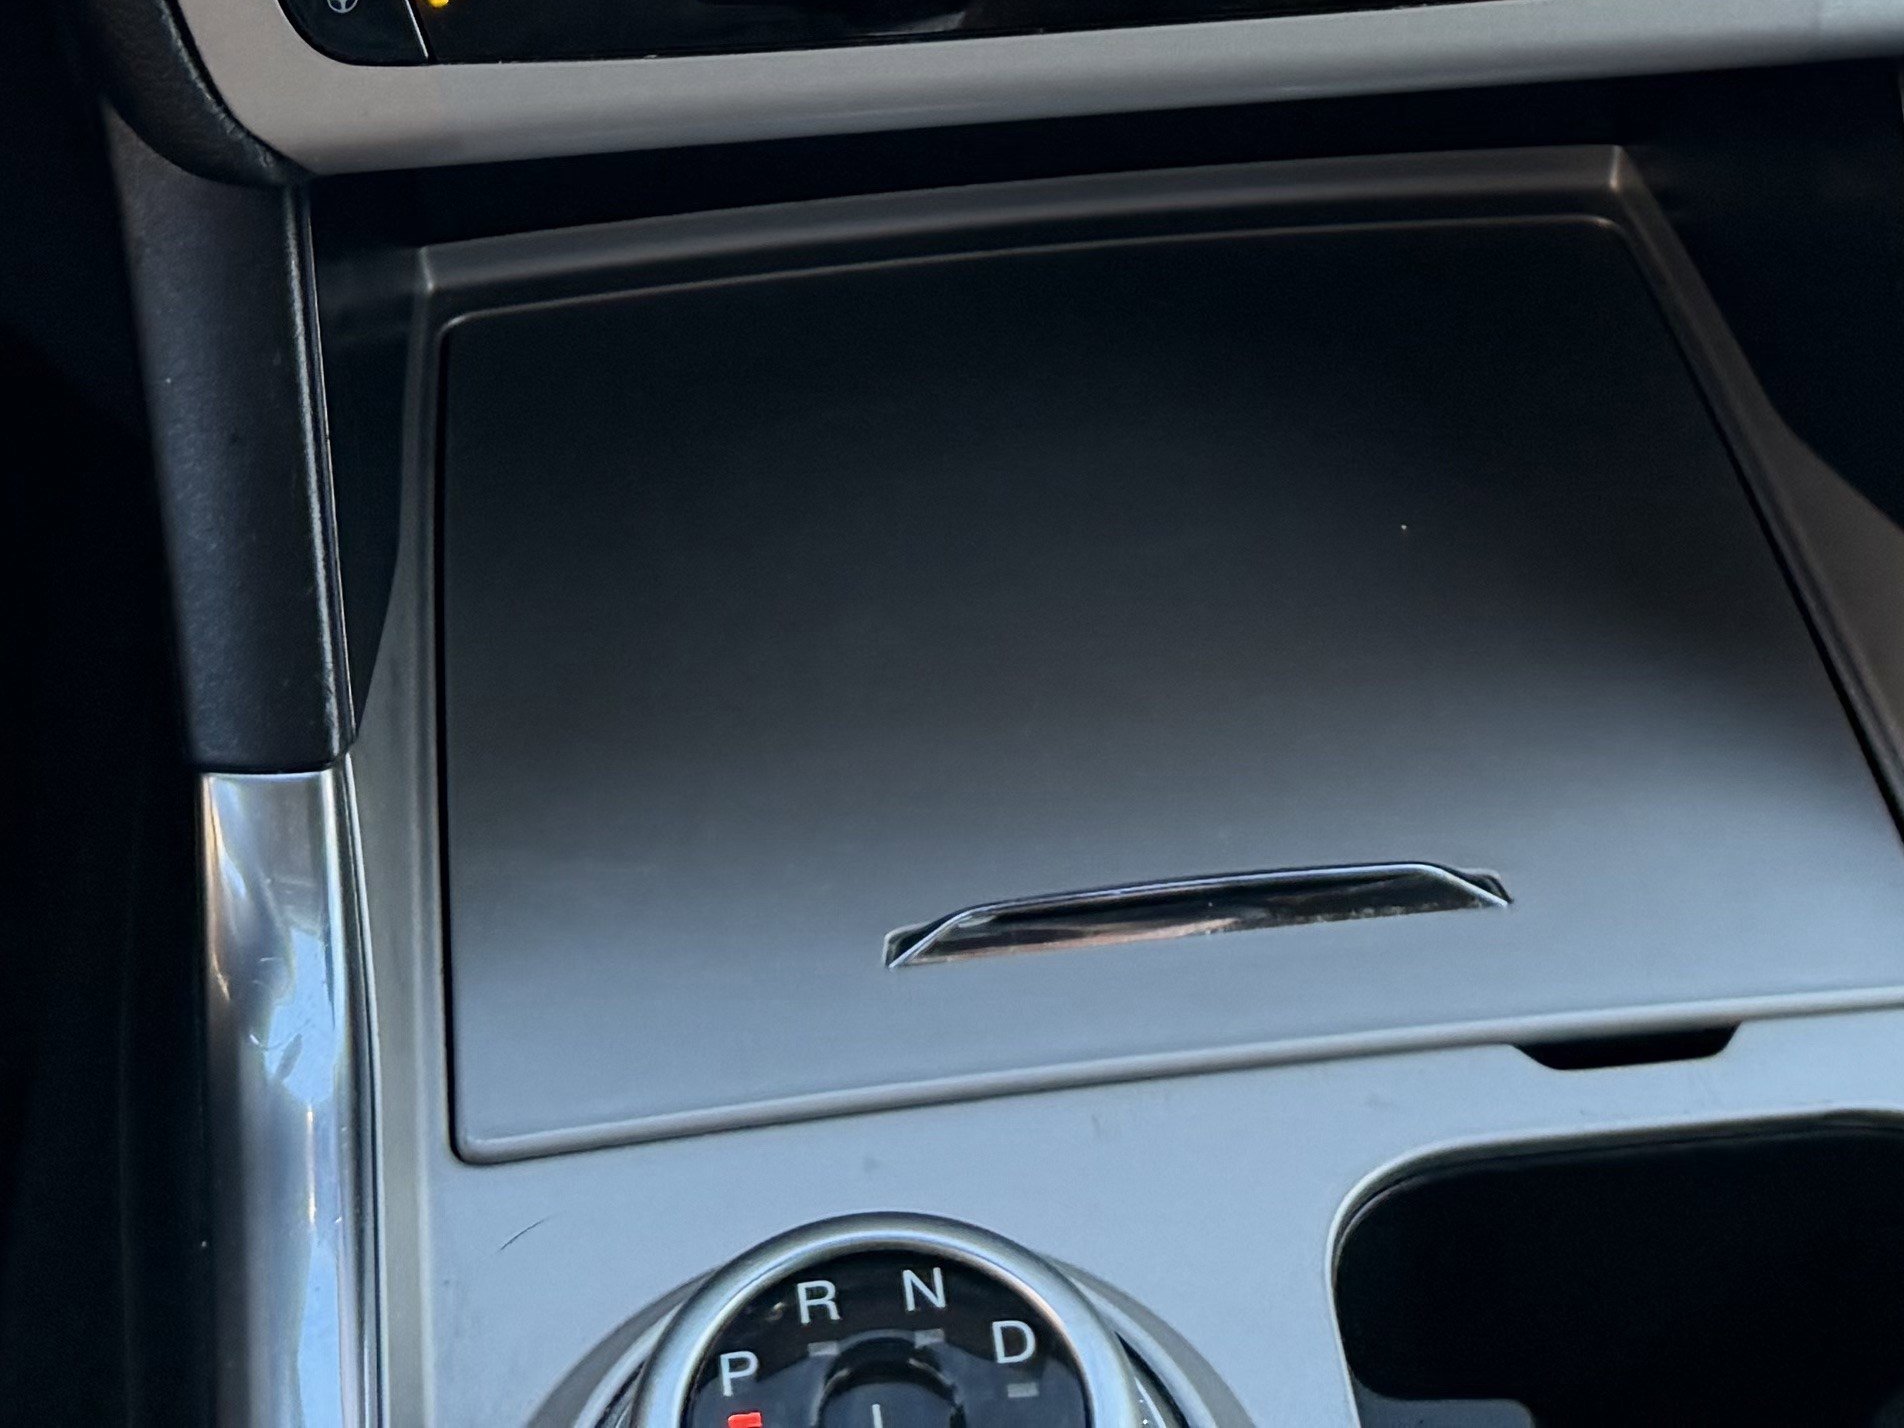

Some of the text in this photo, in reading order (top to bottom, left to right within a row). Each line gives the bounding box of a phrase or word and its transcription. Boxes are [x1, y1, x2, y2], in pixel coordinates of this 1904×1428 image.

[719, 1266, 1037, 1397] P R N D
